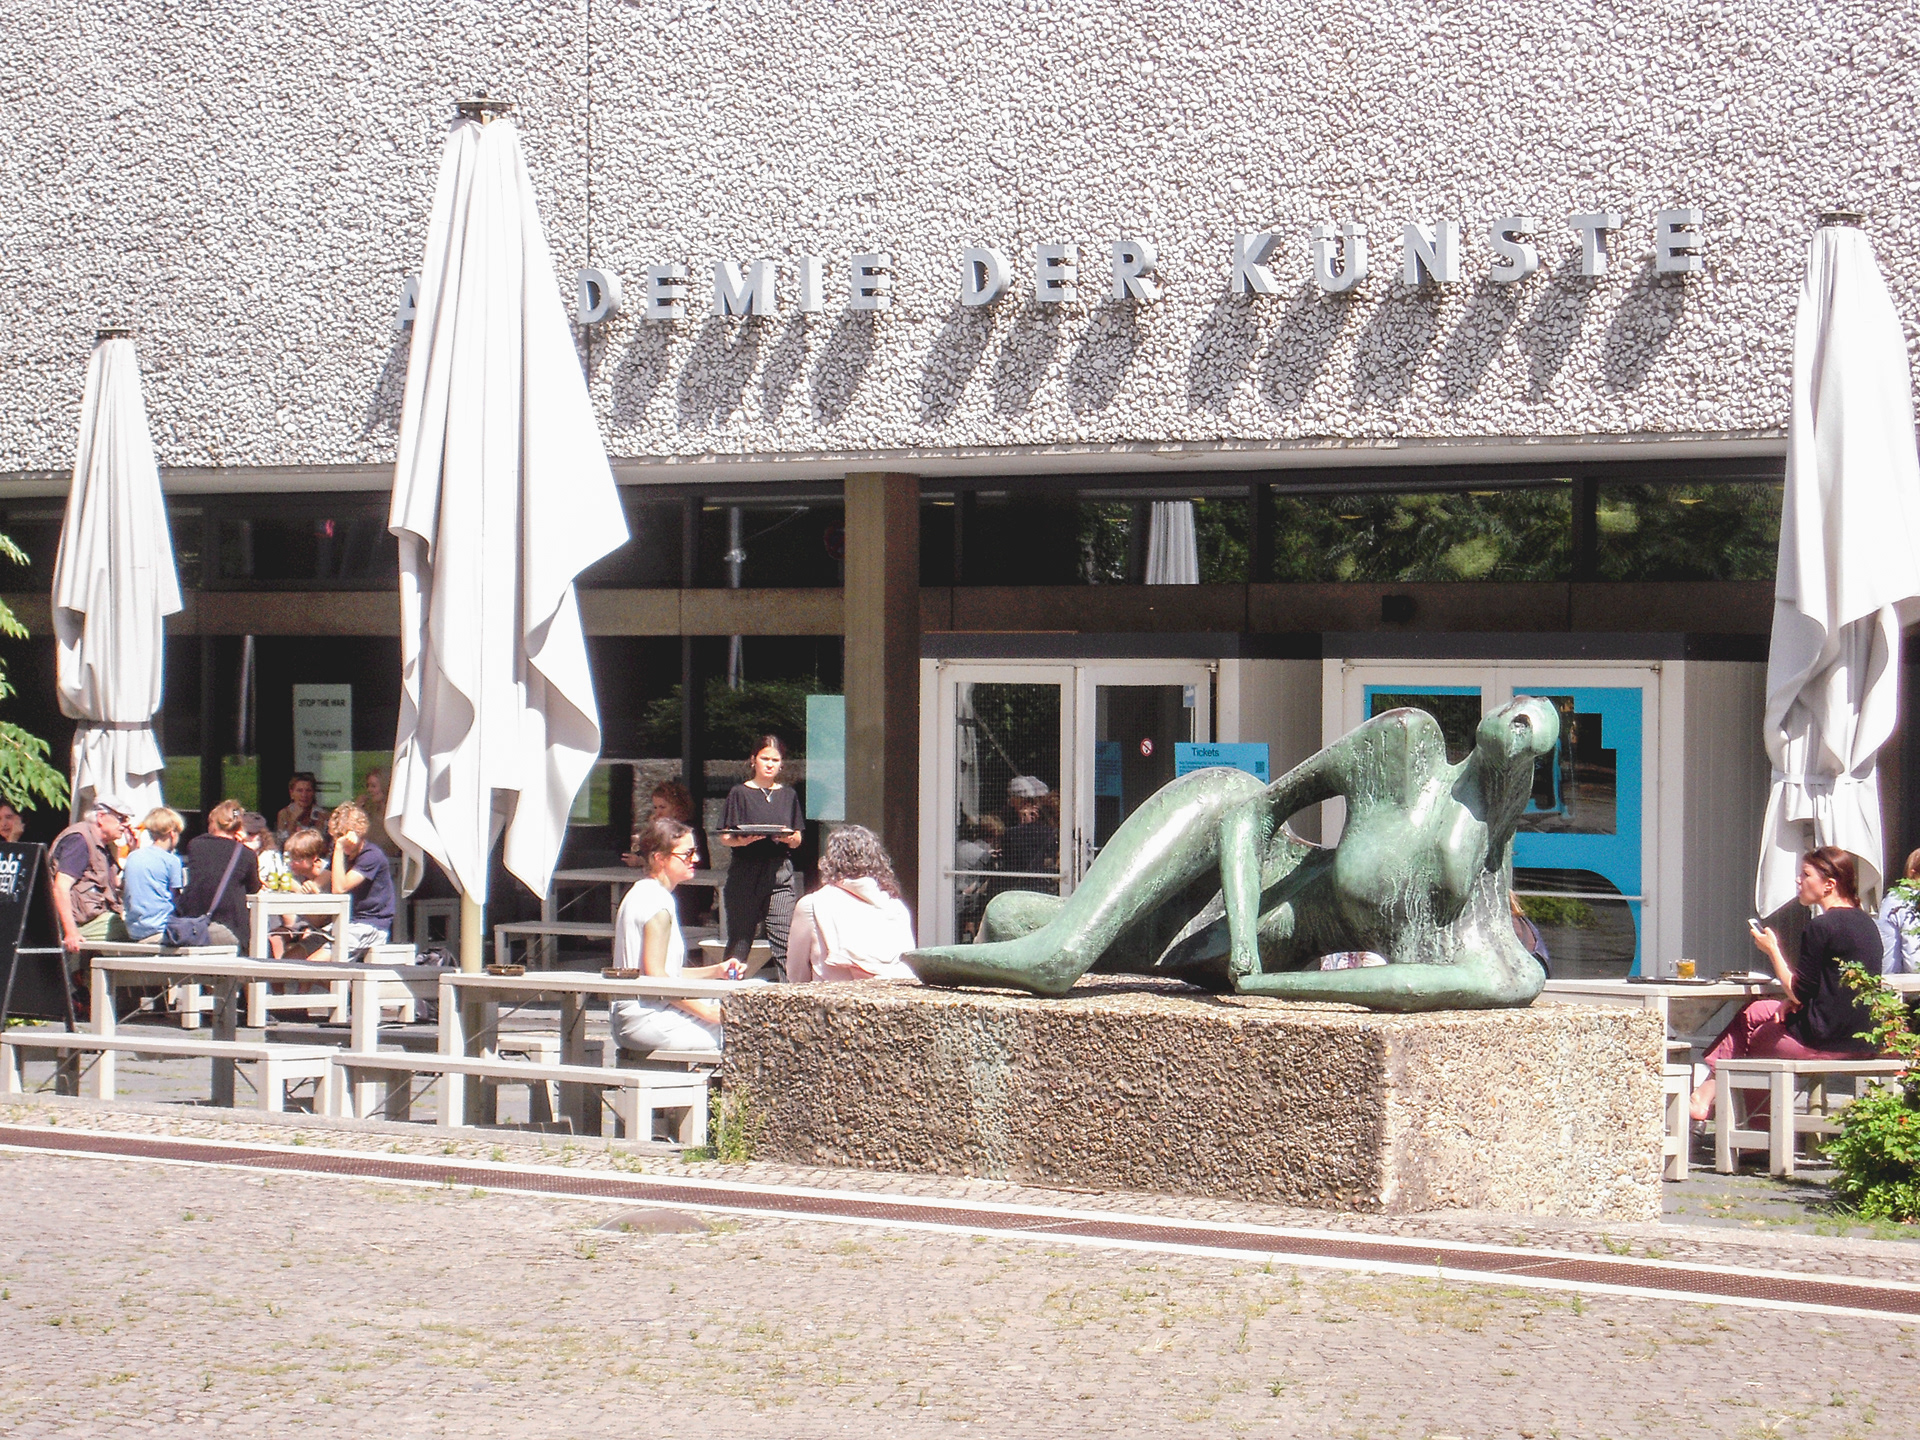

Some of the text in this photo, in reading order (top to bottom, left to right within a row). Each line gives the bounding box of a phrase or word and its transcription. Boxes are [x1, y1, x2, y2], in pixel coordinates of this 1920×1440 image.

[394, 209, 1703, 329] ADEMIE DER KÜNSTE
[1191, 747, 1220, 757] Tickets
